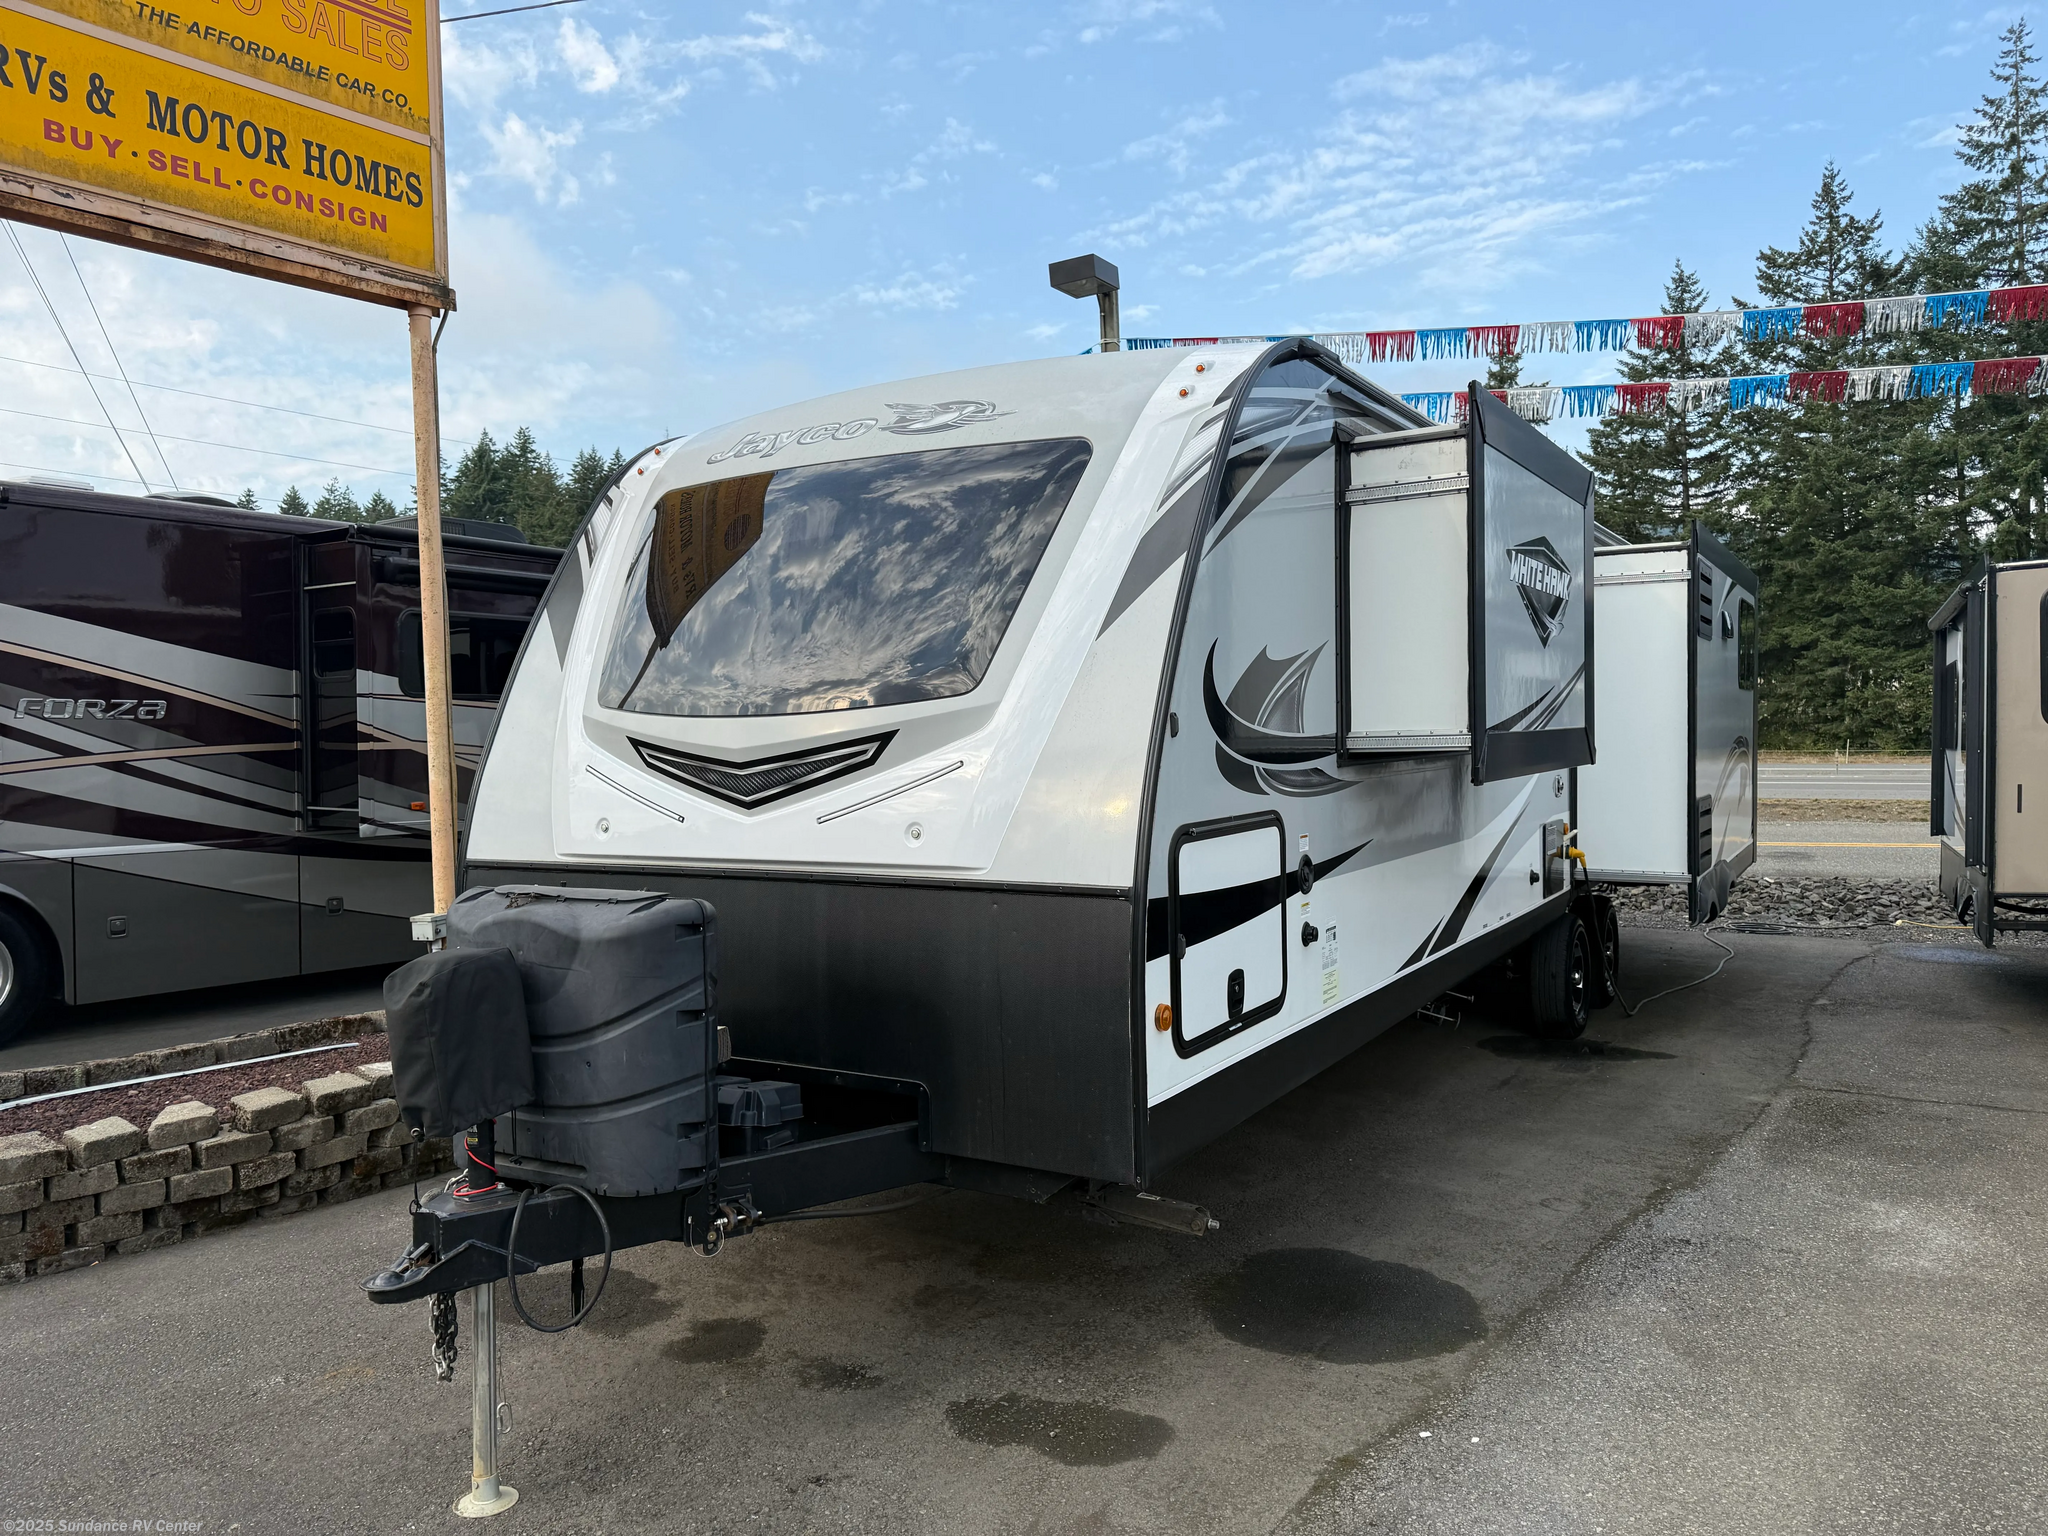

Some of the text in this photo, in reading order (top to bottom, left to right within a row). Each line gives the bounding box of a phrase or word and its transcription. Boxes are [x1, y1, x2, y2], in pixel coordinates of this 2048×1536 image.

[136, 1, 181, 30] THE
[186, 21, 330, 82] AFFORDABLE
[335, 72, 376, 98] CAR
[382, 88, 412, 111] CO.
[281, 0, 410, 71] SALES
[43, 117, 387, 233] BUY SELL CONSIGN
[86, 72, 116, 118] &
[146, 89, 290, 170] MOTOR
[301, 138, 424, 208] HOMES
[706, 417, 879, 465] Jayco
